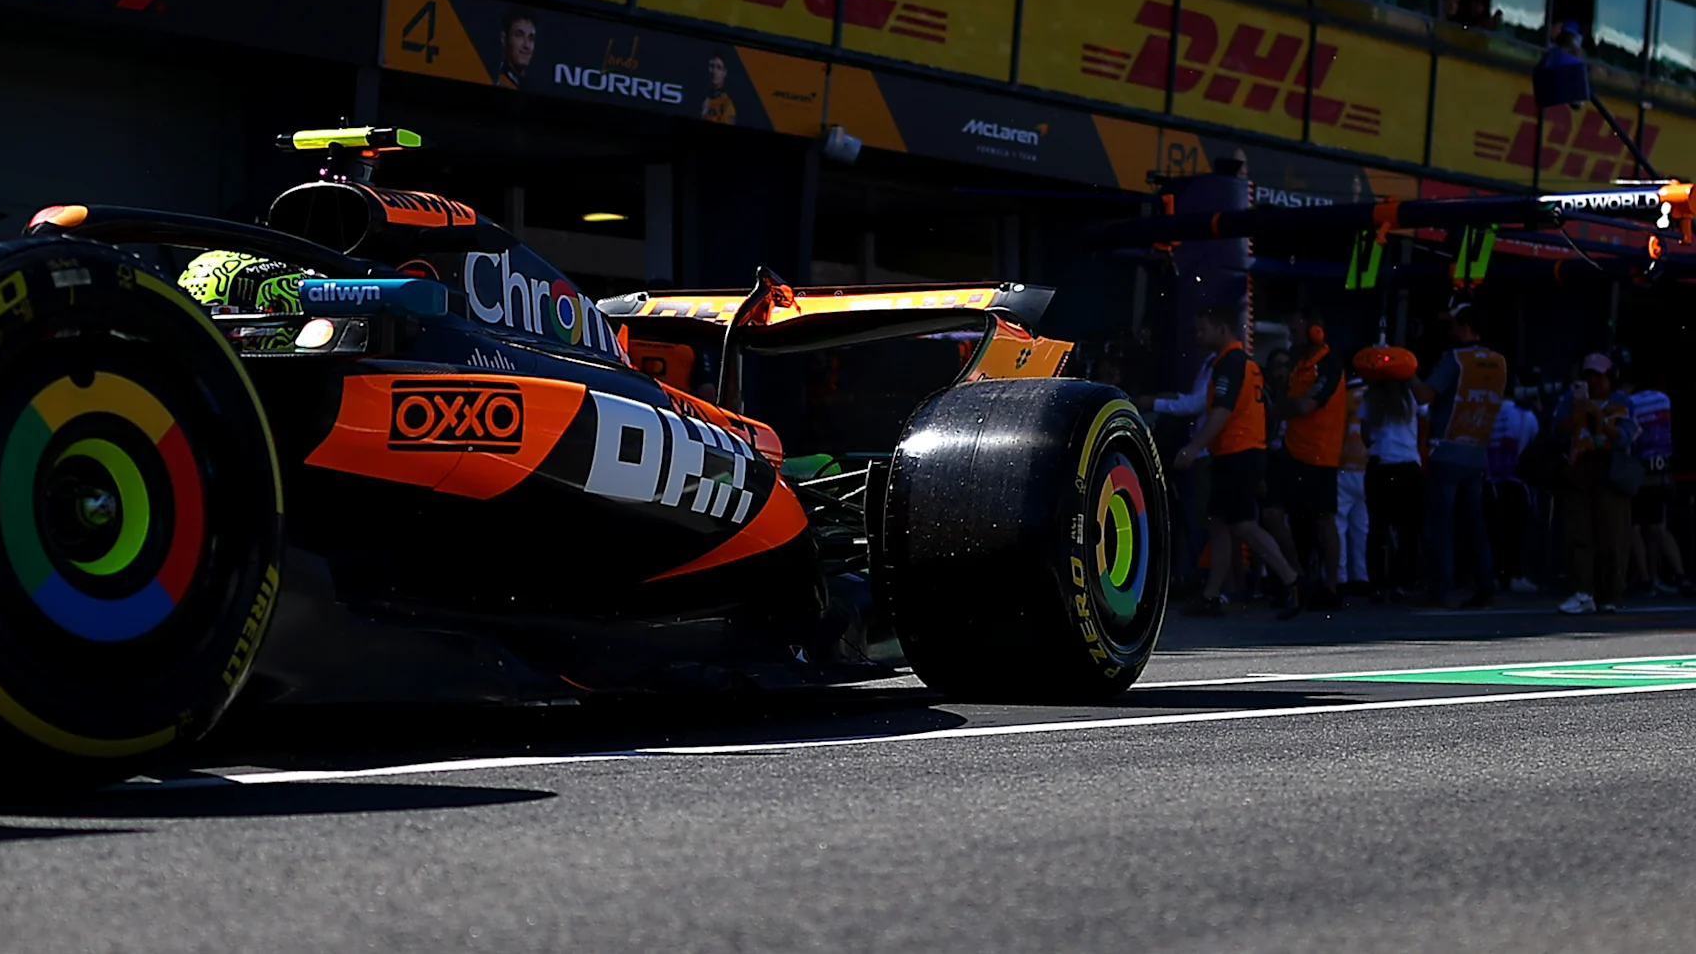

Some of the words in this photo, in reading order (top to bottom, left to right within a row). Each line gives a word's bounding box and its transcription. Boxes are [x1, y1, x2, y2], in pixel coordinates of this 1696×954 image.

[401, 1, 440, 63] 4
[553, 62, 684, 105] NORRIS
[1126, 0, 1346, 124] DHL
[961, 118, 1039, 146] McLaren
[307, 282, 381, 306] allwyn
[395, 394, 522, 439] OXXO
